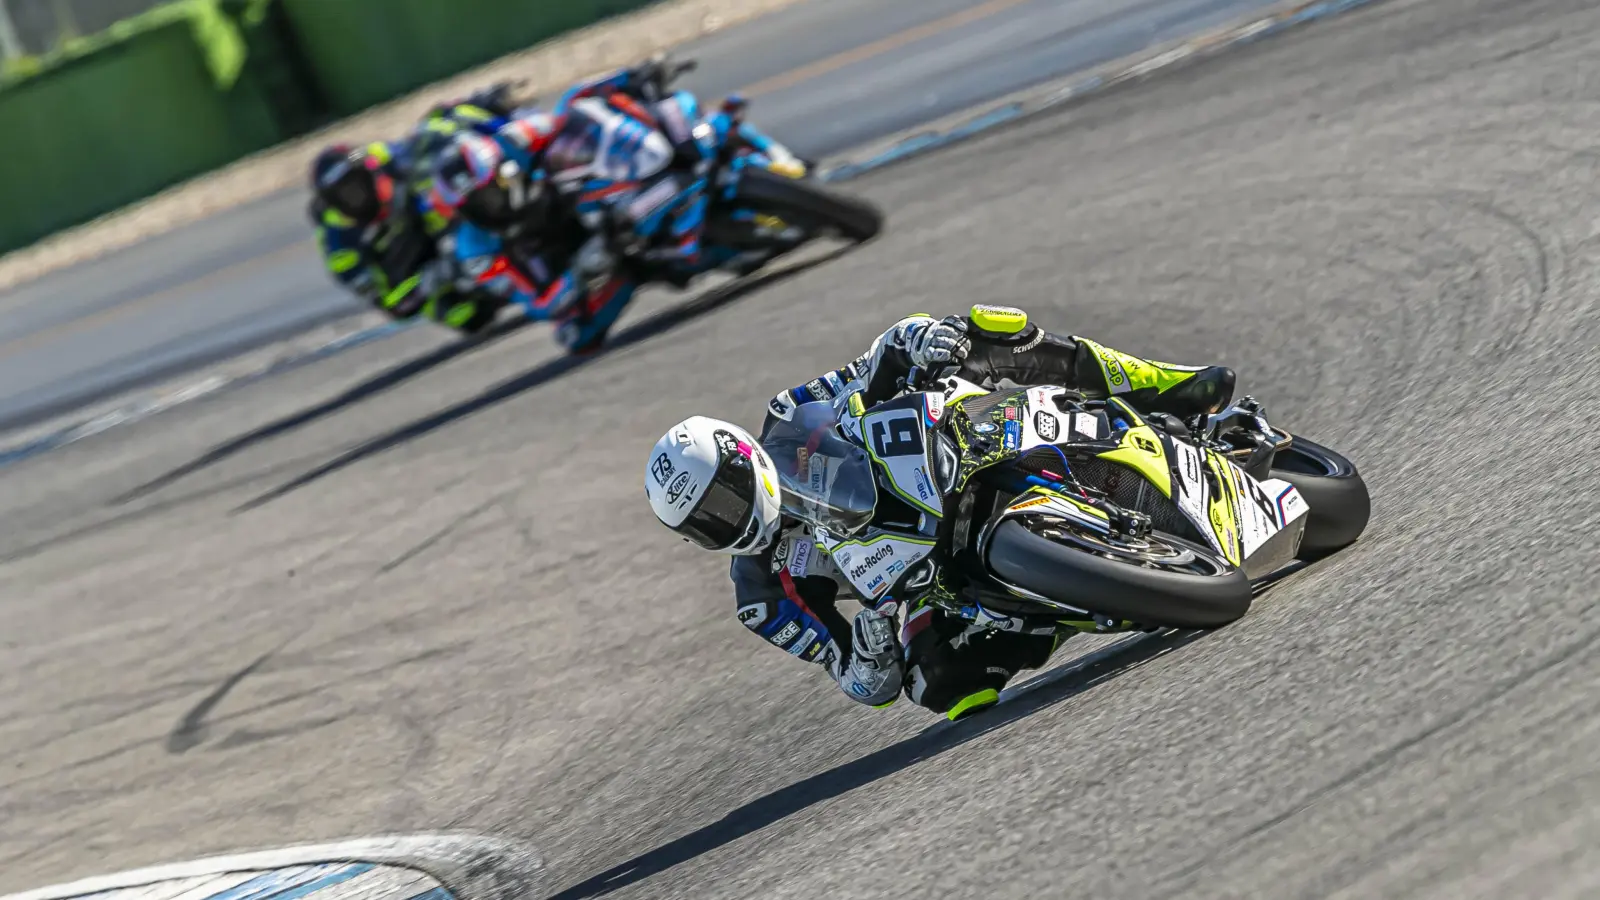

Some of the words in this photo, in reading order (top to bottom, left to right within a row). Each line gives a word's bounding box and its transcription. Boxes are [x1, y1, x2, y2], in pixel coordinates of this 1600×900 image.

[667, 475, 688, 503] X-lite
[773, 540, 787, 569] X-lite
[790, 542, 808, 575] elmos
[867, 574, 883, 590] BLACH
[772, 624, 799, 645] SEGE
